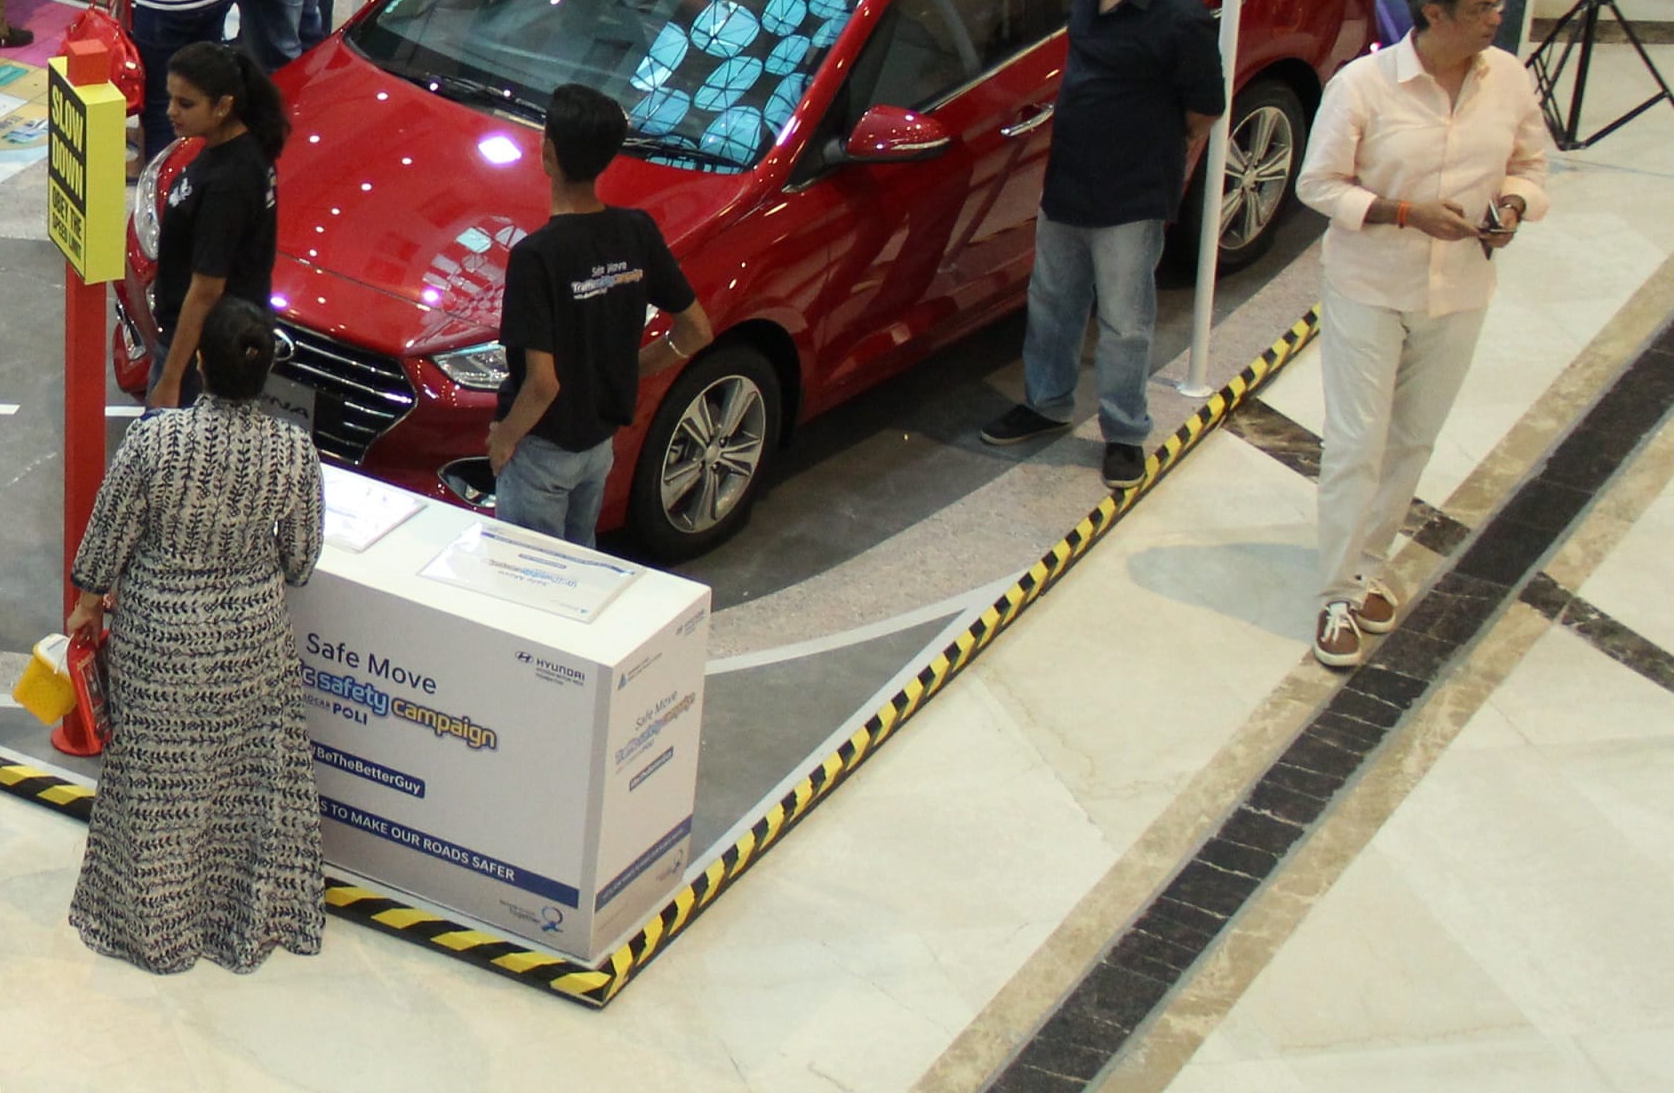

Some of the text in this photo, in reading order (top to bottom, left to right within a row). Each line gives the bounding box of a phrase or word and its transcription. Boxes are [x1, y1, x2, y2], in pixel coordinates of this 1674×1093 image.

[52, 85, 83, 152] SLOW
[52, 132, 83, 200] DOWN
[52, 186, 82, 239] OBEY THE
[52, 212, 82, 261] SPEED LIMIT
[306, 633, 436, 695] Safe Move
[536, 658, 585, 681] HYUNDAI
[317, 670, 388, 716] safety
[390, 697, 498, 750] campaign
[333, 702, 368, 726] POLI
[635, 690, 677, 731] Safe Move
[331, 804, 347, 820] TO
[351, 811, 388, 835] MAKE
[391, 826, 420, 846] OUR
[423, 838, 469, 864] ROADS
[472, 856, 515, 881] SAFER
